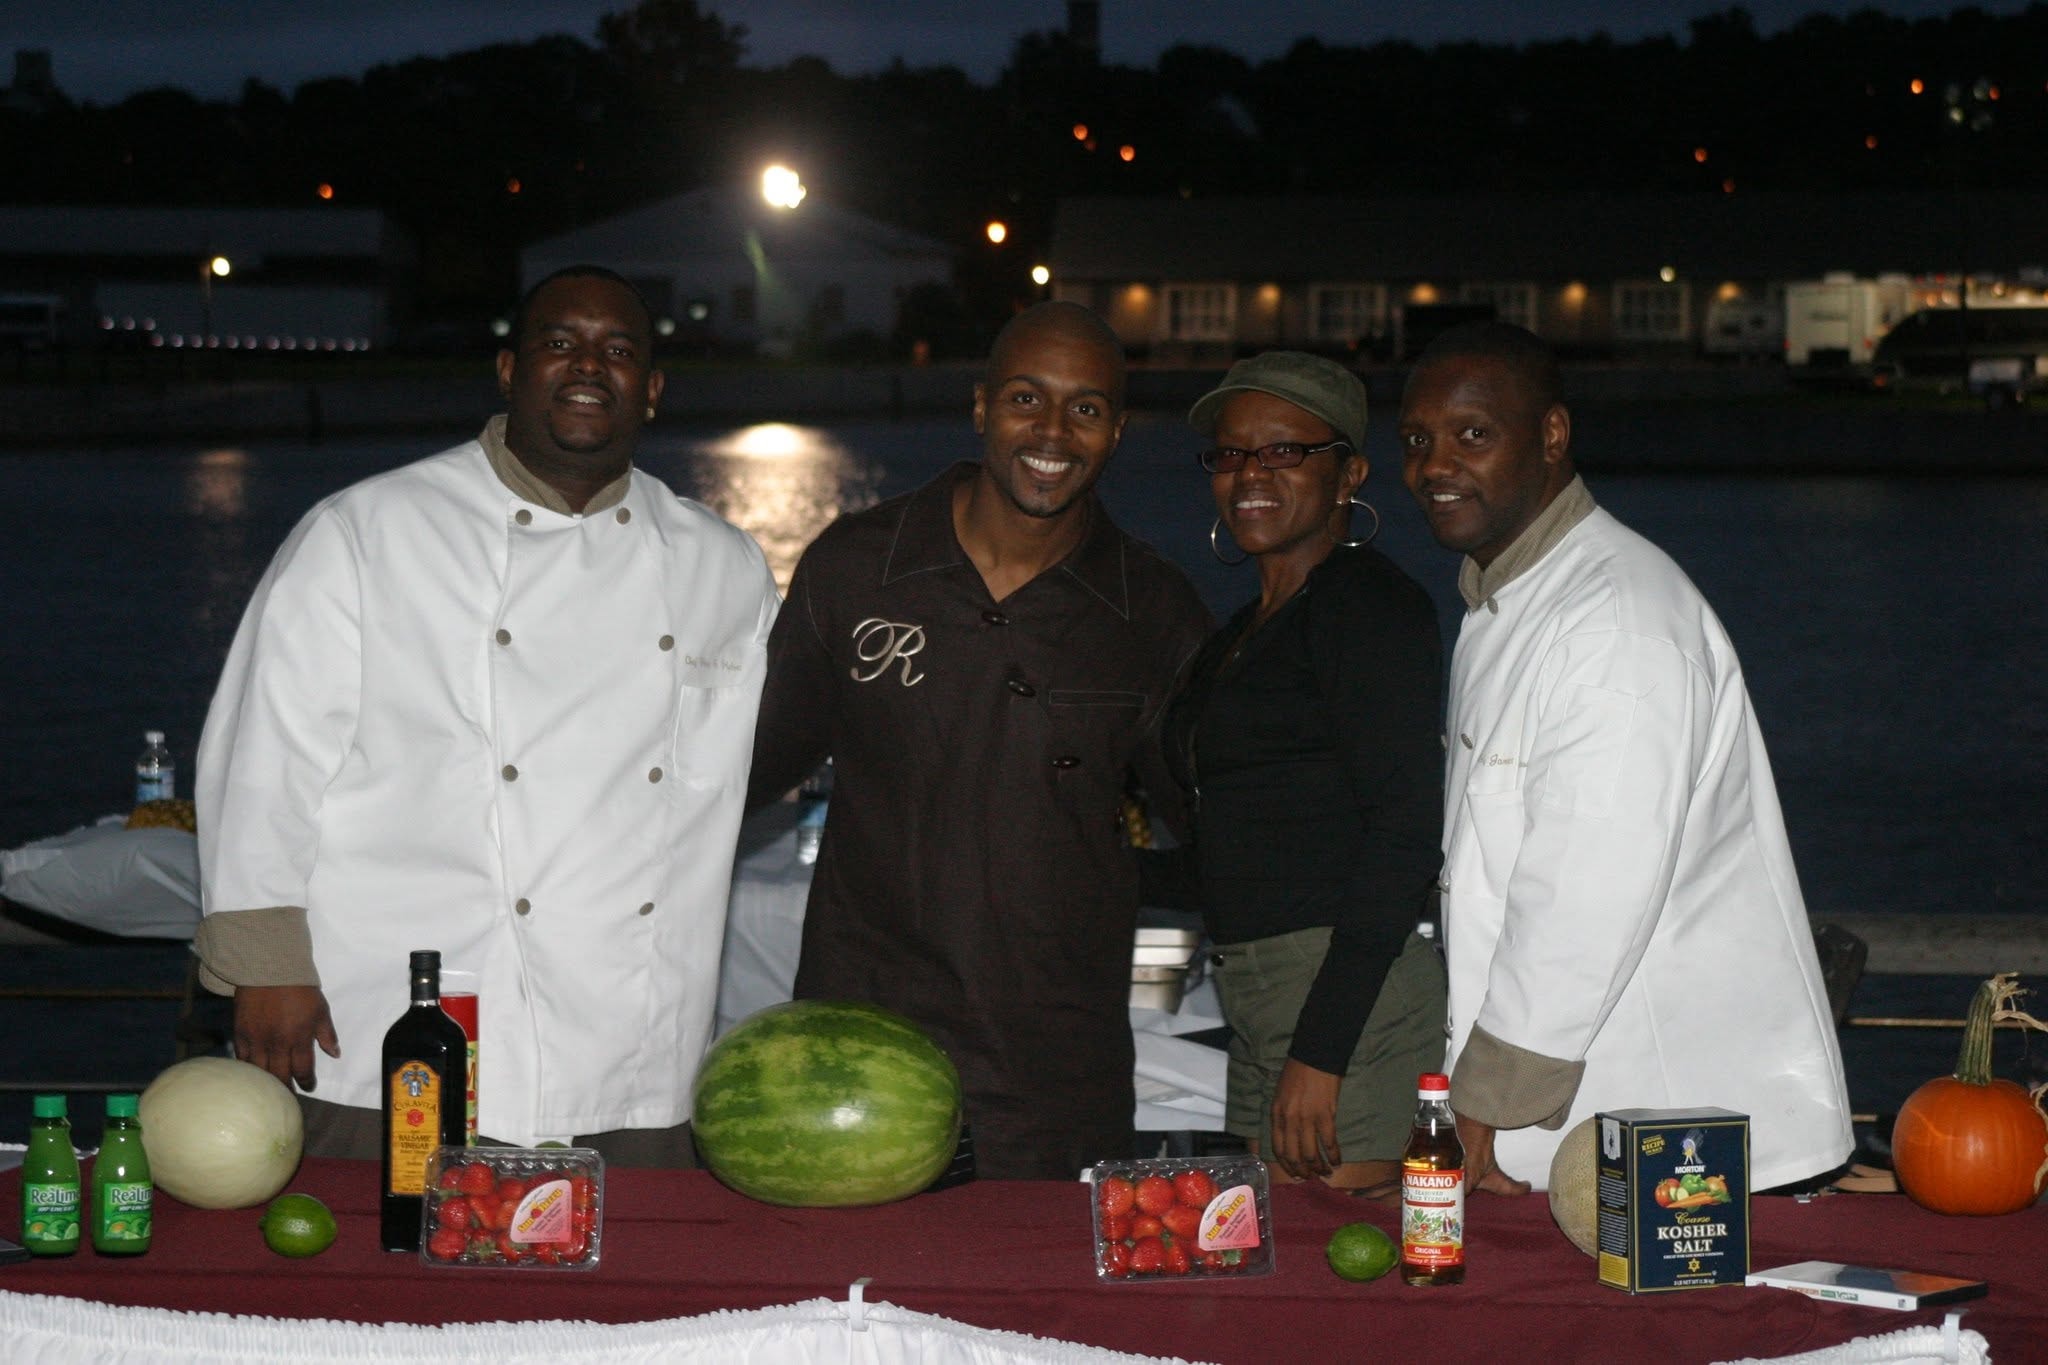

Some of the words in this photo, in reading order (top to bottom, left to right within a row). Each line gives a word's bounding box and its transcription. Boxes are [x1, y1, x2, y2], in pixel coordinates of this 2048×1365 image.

[850, 618, 926, 687] R
[1674, 1164, 1705, 1175] MORTON
[1406, 1174, 1453, 1188] NAKANO
[1657, 1223, 1728, 1241] KOSHER
[1673, 1239, 1713, 1254] SALT
